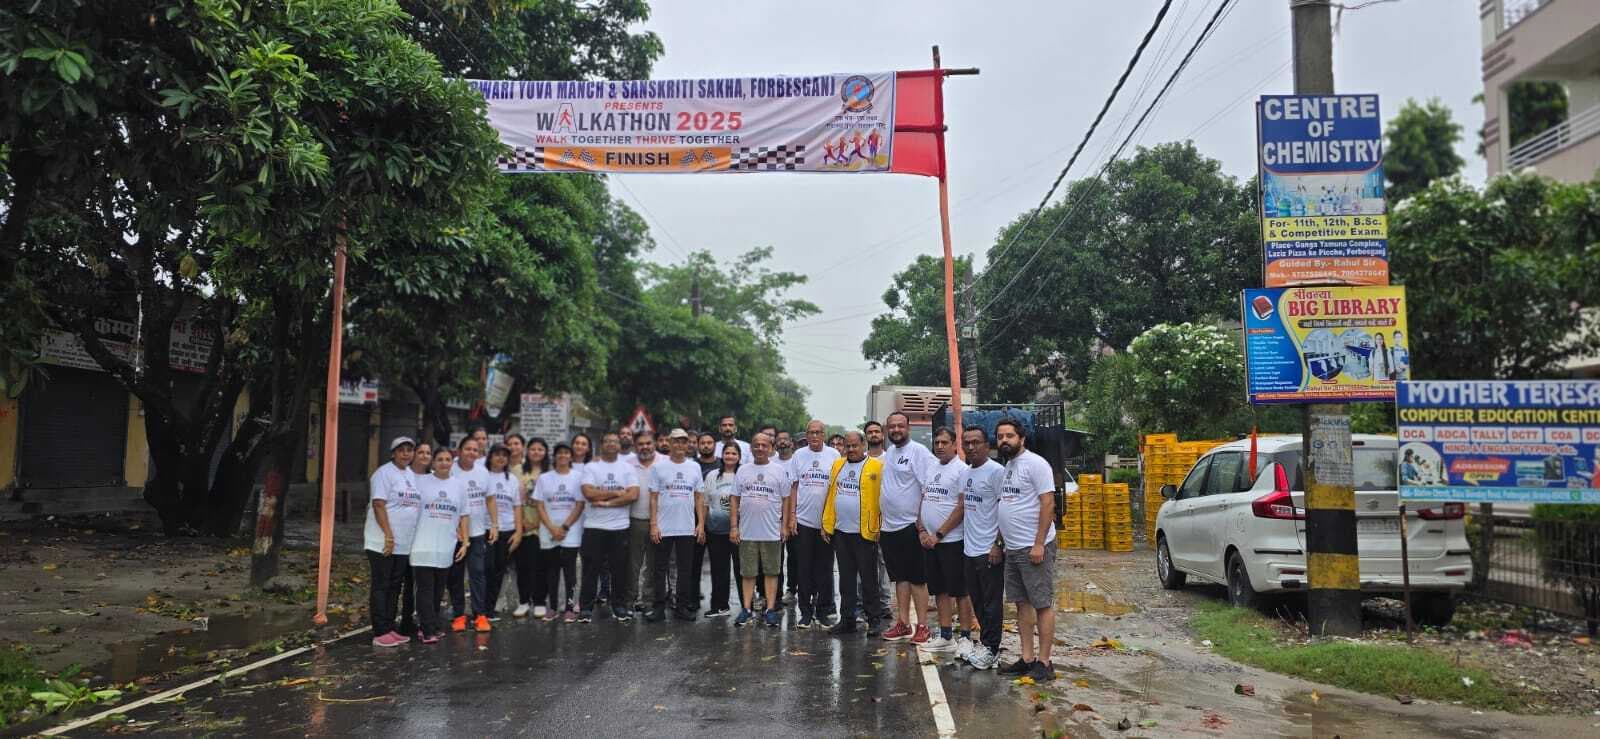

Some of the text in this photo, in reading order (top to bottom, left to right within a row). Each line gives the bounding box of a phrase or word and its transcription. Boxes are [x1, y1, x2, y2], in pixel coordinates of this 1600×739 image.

[520, 82, 552, 100] YUVA
[557, 82, 604, 100] MANCH
[609, 82, 616, 99] &
[622, 80, 694, 100] SANSKRITI
[698, 78, 746, 100] SAKHA,
[750, 76, 836, 98] FORBESGANJ
[604, 102, 664, 111] PRESENTS
[1264, 96, 1377, 120] CENTRE
[537, 102, 742, 133] WALKATHON 2025
[1308, 121, 1335, 137] OF
[536, 136, 740, 144] WALK TOGETHER THRIVE TOGETHER
[606, 152, 670, 166] FINISH
[1264, 139, 1380, 165] CHEMISTRY
[1270, 218, 1382, 228] For- 11th, 12th, B.Sc.
[1269, 228, 1384, 239] & Competitive Exam.
[1288, 298, 1401, 316] BIG LIBRARY
[1408, 382, 1600, 406] MOTHER TERESA
[1400, 409, 1474, 423] COMPUTER
[1478, 409, 1558, 423] EDUCATION
[1404, 430, 1426, 439] DCA
[1436, 430, 1468, 439] ADCA
[1471, 430, 1505, 439] TALLY
